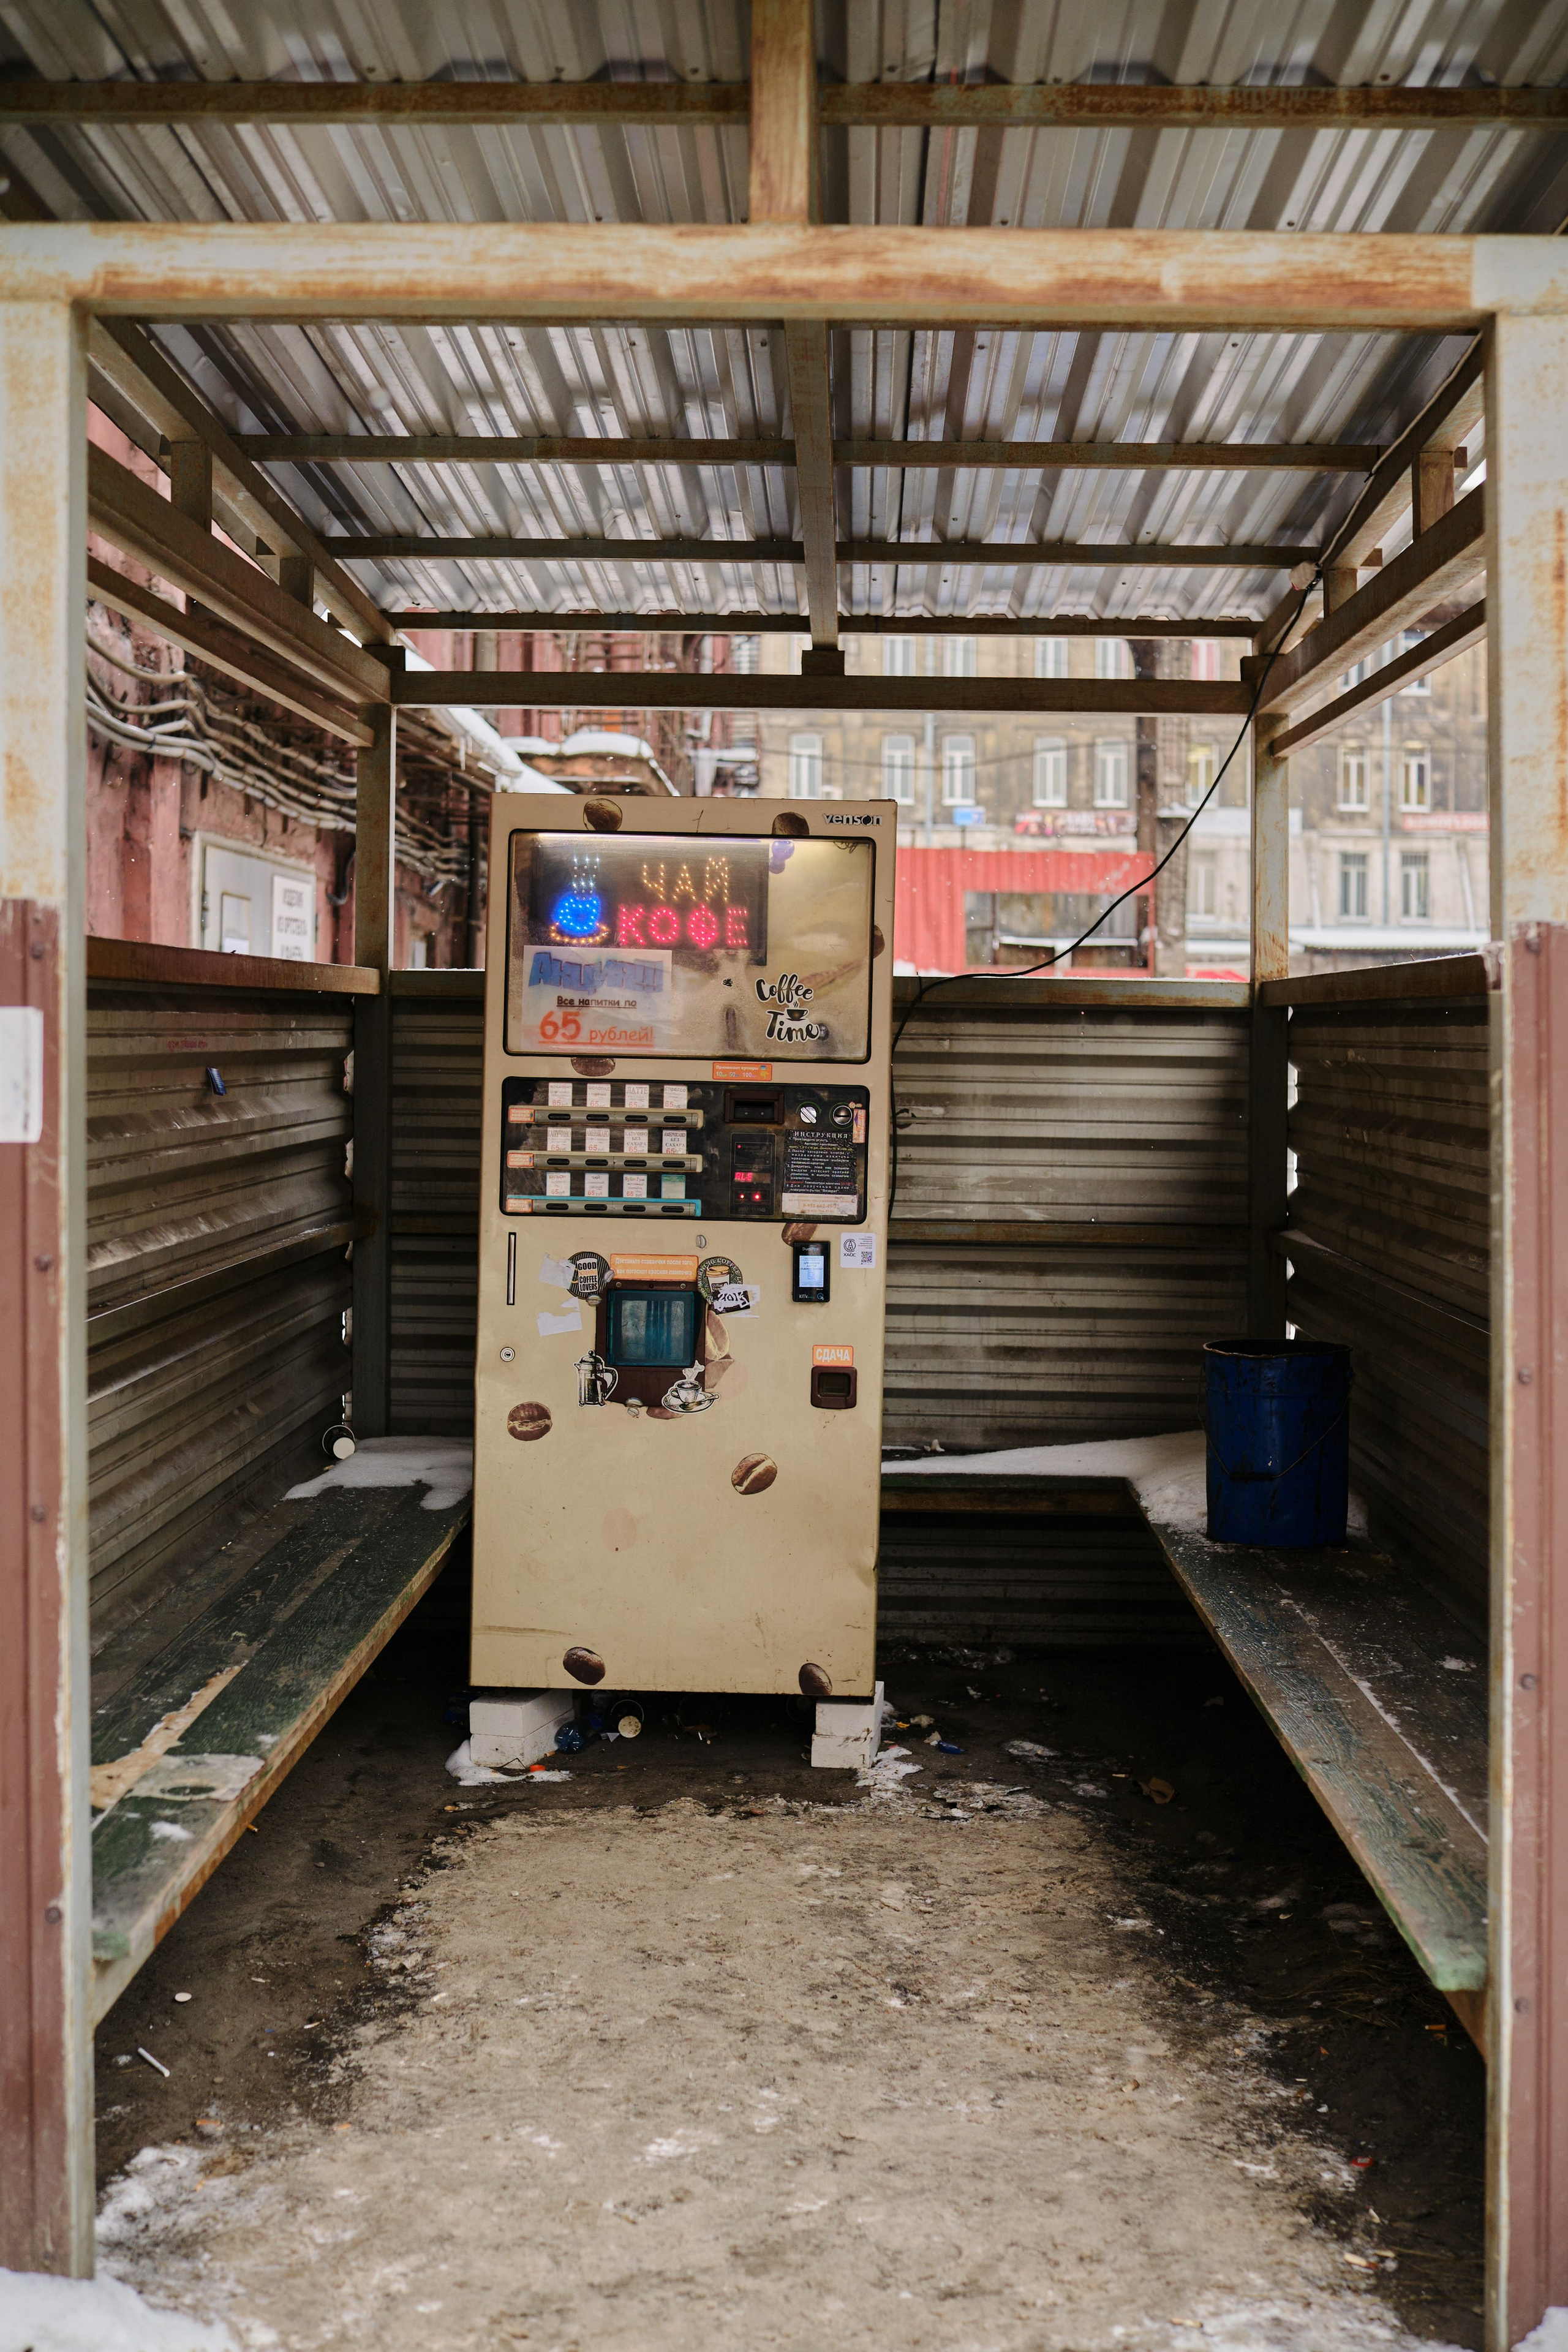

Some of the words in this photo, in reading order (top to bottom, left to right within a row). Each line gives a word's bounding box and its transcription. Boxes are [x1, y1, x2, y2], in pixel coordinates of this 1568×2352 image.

[823, 814, 882, 826] venson
[643, 858, 728, 901] ЧАЙ
[620, 905, 748, 948] КОФЕ
[756, 974, 813, 1003] Coffee
[557, 996, 575, 1005] Все
[579, 998, 620, 1006] напитки
[540, 1011, 581, 1040] 65
[589, 1026, 654, 1042] рублей!
[767, 1011, 819, 1041] Time
[578, 1262, 597, 1270] GOOD
[579, 1275, 598, 1284] COFFEE
[816, 1348, 850, 1363] СДАЧА
